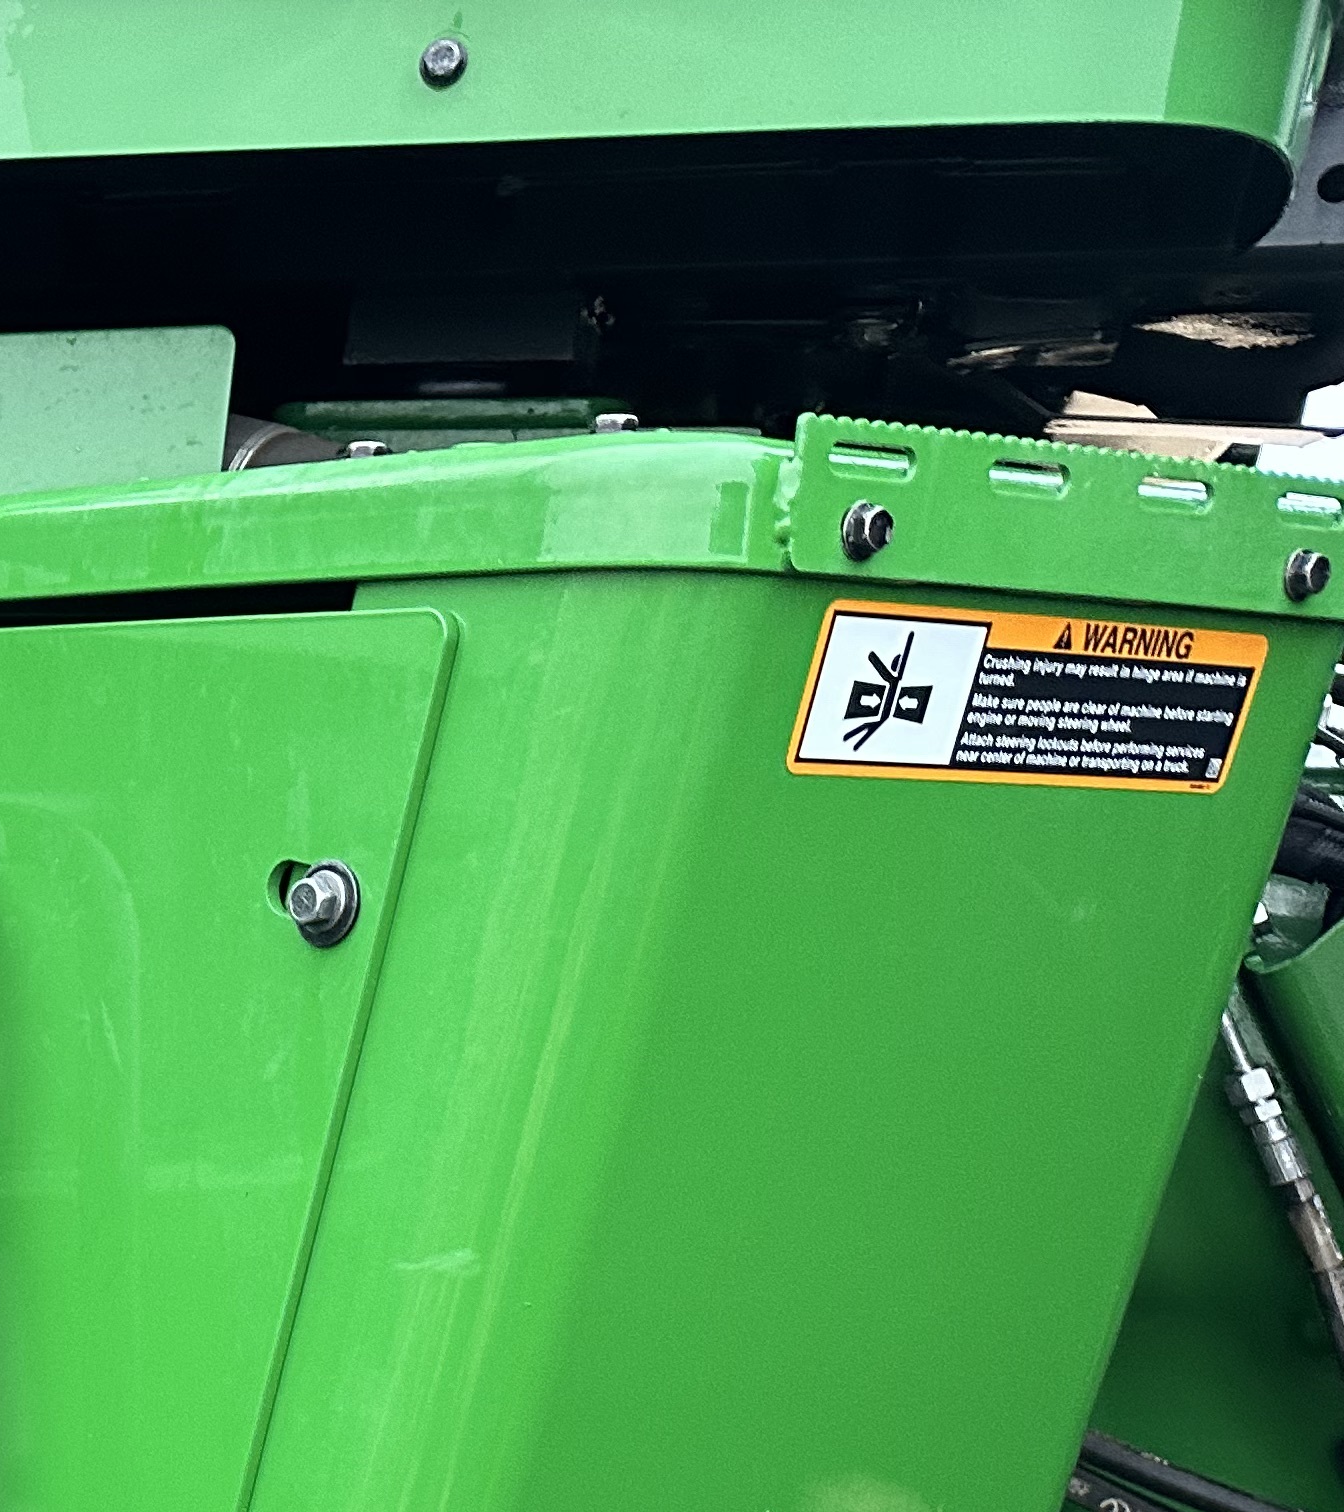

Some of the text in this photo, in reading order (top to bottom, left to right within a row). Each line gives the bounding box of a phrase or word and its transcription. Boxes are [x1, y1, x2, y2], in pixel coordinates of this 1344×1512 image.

[1083, 623, 1194, 659] WARNING
[983, 653, 1032, 674] Crushing
[1033, 657, 1064, 676] injury
[1065, 662, 1088, 678] may
[1088, 663, 1119, 678] result
[1161, 669, 1185, 682] area
[1194, 670, 1236, 686] machine
[972, 692, 1000, 708] Make
[1001, 697, 1025, 710] sure
[1025, 697, 1062, 713] people
[1062, 701, 1081, 713] are
[1081, 699, 1108, 714] clear
[1107, 701, 1121, 715] of
[1120, 703, 1163, 719] machine
[1163, 705, 1196, 720] before
[966, 710, 1003, 727] engine
[1004, 714, 1017, 725] or
[1017, 713, 1056, 731] moving
[960, 731, 994, 746] Attach
[1080, 737, 1112, 753] before
[980, 749, 1013, 763] center
[1013, 750, 1027, 764] of
[1025, 751, 1068, 767] machine
[1068, 755, 1081, 767] or
